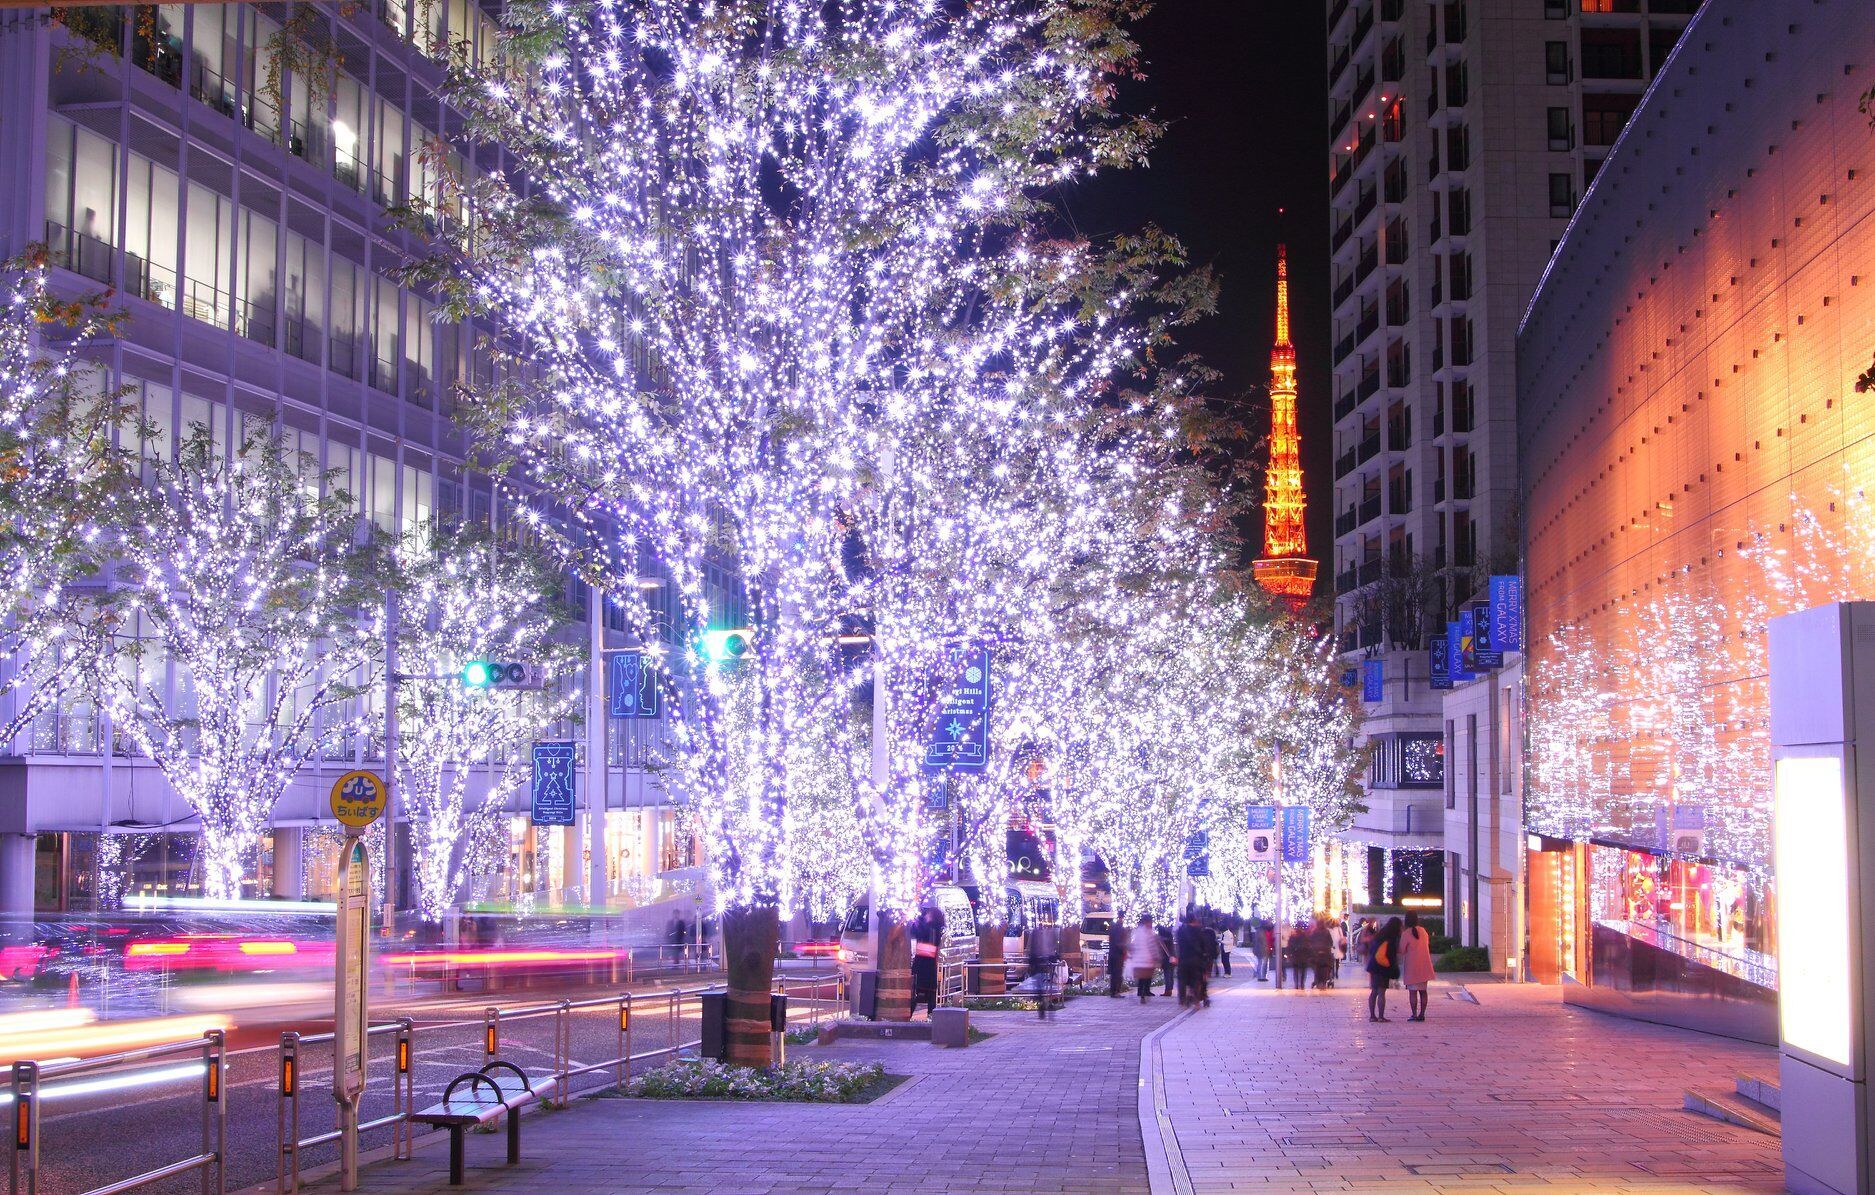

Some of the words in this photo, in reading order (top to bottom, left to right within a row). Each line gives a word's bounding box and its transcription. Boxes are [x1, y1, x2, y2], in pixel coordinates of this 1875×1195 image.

[1508, 581, 1517, 613] MERRY
[1496, 602, 1507, 644] GALAXY
[1508, 615, 1517, 644] X'MAS
[1453, 642, 1461, 675] GALAXY
[946, 744, 964, 752] 204
[1296, 809, 1304, 834] MERRY
[1287, 825, 1296, 857] GALAXY
